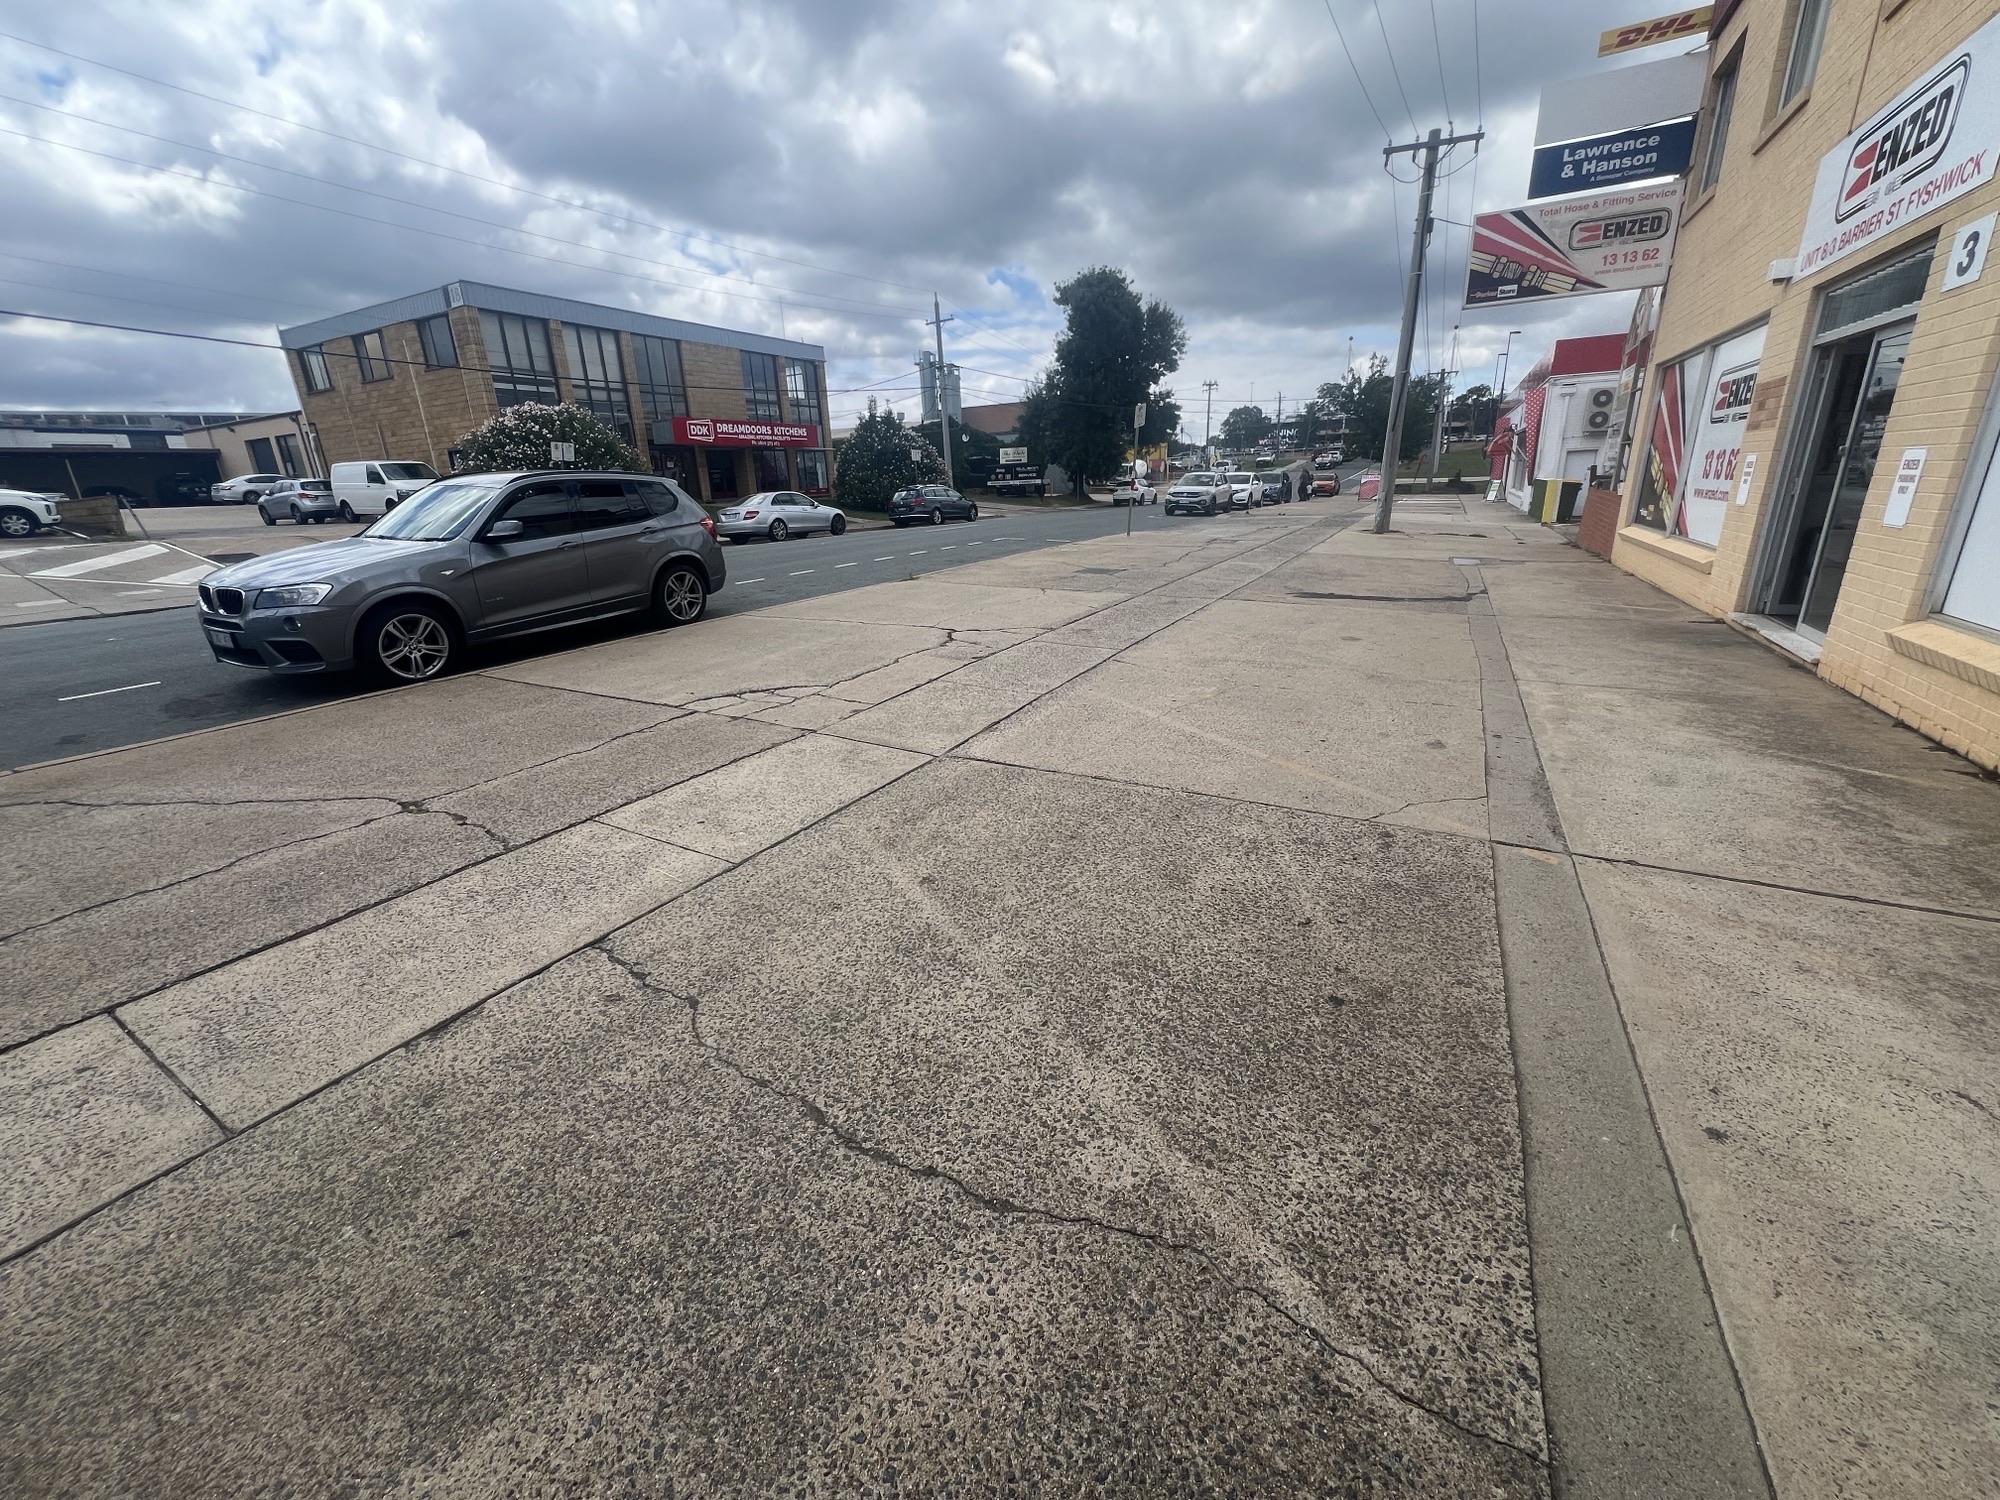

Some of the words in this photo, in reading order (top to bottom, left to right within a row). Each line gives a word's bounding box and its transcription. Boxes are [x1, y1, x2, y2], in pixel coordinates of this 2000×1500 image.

[1613, 13, 1698, 49] DHL
[1563, 135, 1660, 162] Lawrence
[1870, 85, 1954, 186] ENZED
[1561, 165, 1575, 178] &
[1582, 152, 1658, 175] Hanson
[1624, 167, 1655, 177] Company
[1539, 208, 1561, 218] Total
[1564, 203, 1590, 213] Hose
[1592, 201, 1599, 209] &
[1602, 195, 1634, 208] Fitting
[1637, 189, 1677, 201] Service
[1800, 249, 1820, 272] UNIT
[1838, 212, 1884, 251] BARRIER
[1886, 201, 1904, 226] ST
[1905, 149, 1987, 216] FYSHWICK
[1602, 215, 1664, 240] ENZED
[1602, 253, 1617, 267] 13
[1622, 250, 1638, 265] 13
[1642, 248, 1660, 261] 62
[1956, 230, 1980, 278] 3
[690, 425, 709, 435] DDK
[717, 424, 772, 435] DREAMDOORS
[774, 427, 807, 437] KITCHENS
[1702, 449, 1713, 479] 13
[1713, 449, 1724, 480] 13
[1902, 459, 1920, 470] ENZED
